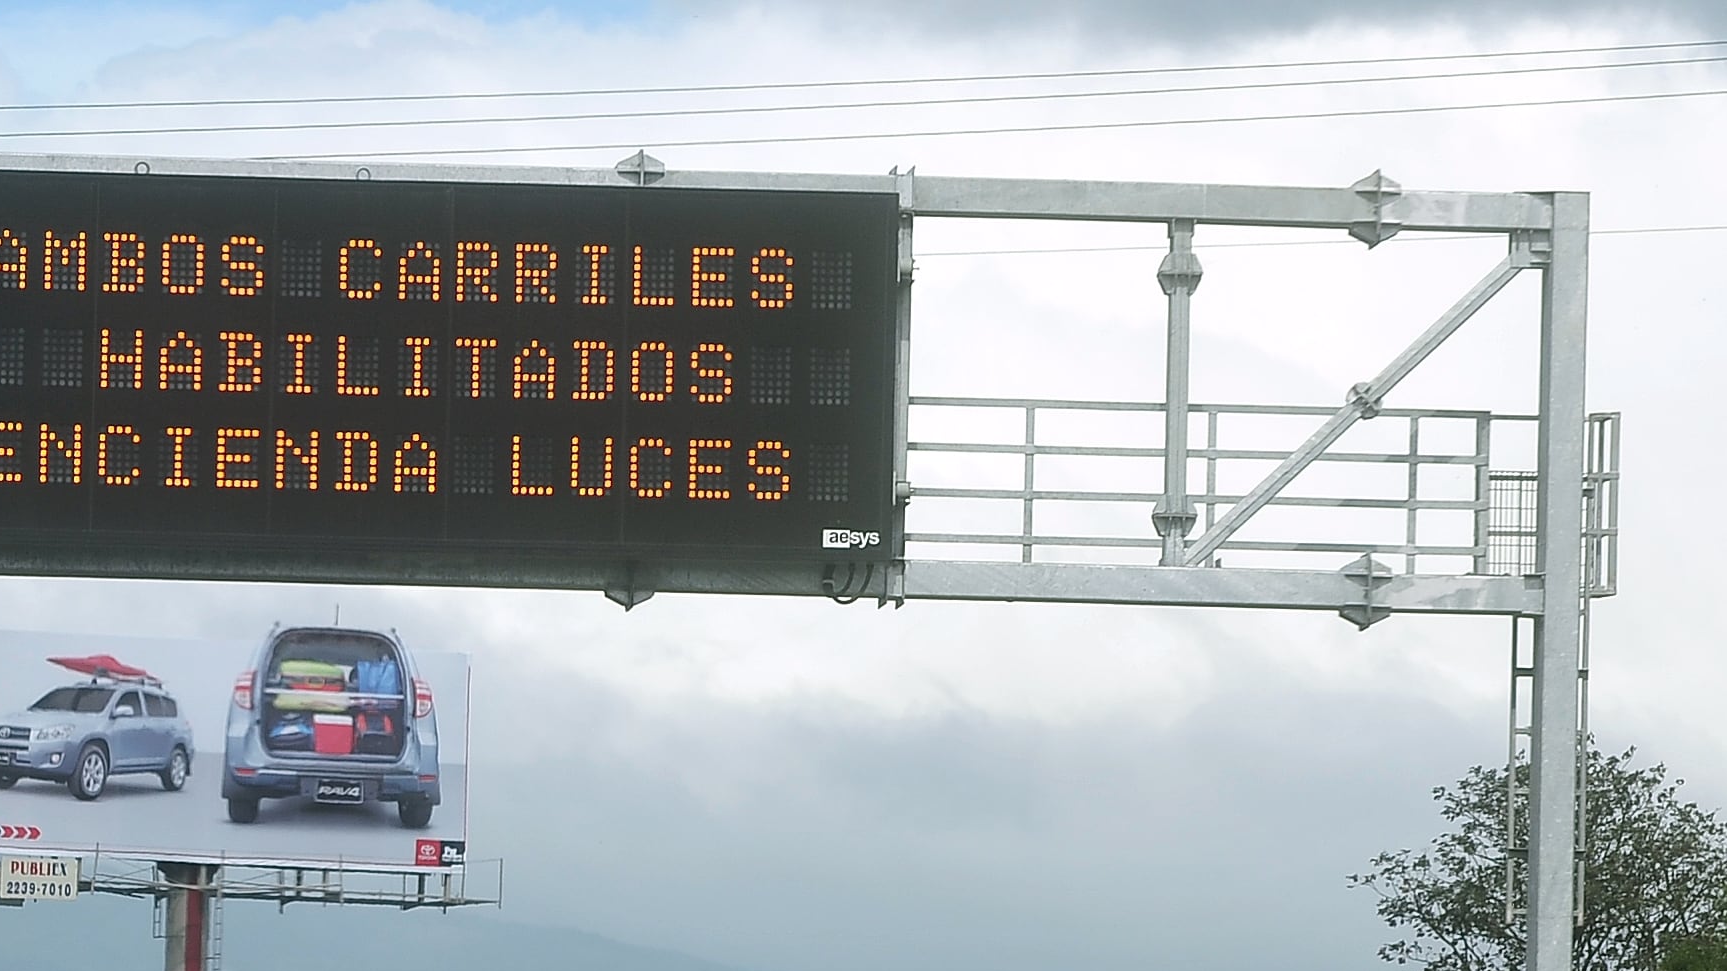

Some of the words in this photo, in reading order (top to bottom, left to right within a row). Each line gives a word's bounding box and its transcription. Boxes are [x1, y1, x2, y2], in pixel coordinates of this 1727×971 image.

[338, 237, 796, 310] CARRILES
[98, 327, 734, 405] HABILITADOS
[510, 433, 792, 501] LUCES
[823, 530, 880, 549] aesys
[318, 783, 360, 797] RAV4
[6, 881, 72, 897] 2239-7010
